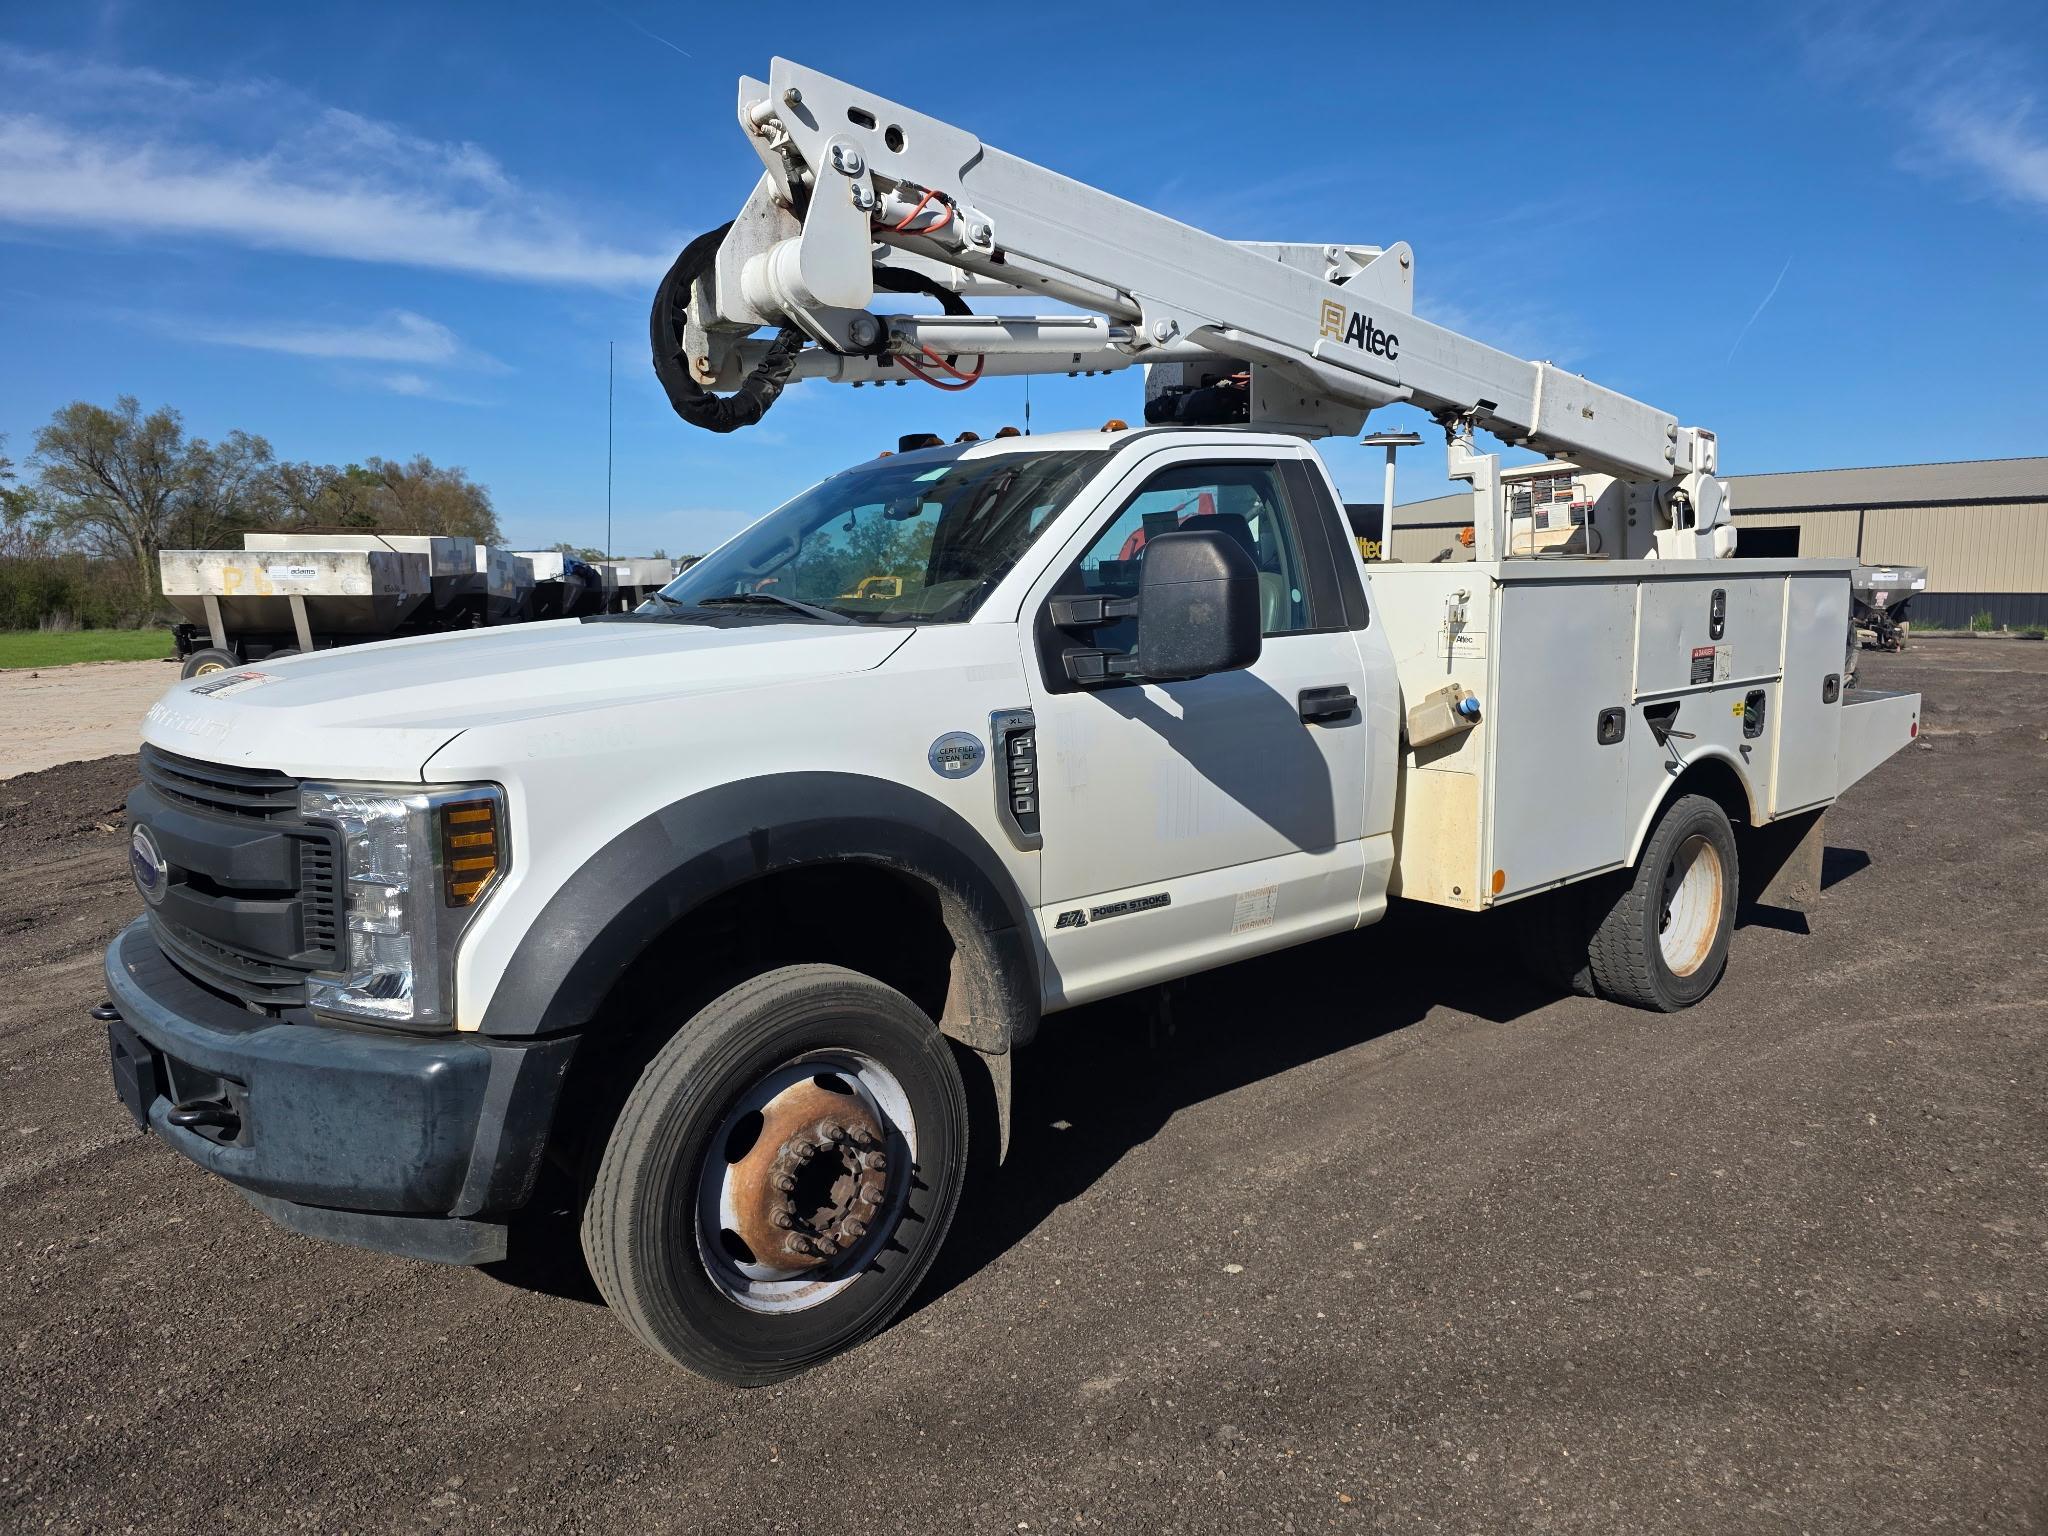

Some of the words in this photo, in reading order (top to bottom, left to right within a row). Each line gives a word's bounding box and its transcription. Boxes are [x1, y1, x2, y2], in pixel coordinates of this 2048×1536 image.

[1344, 312, 1399, 360] Altec
[940, 745, 974, 755] CERTIFIED
[937, 755, 960, 763] CLEAN
[1093, 902, 1128, 917] POWER
[1129, 894, 1168, 909] STROKE
